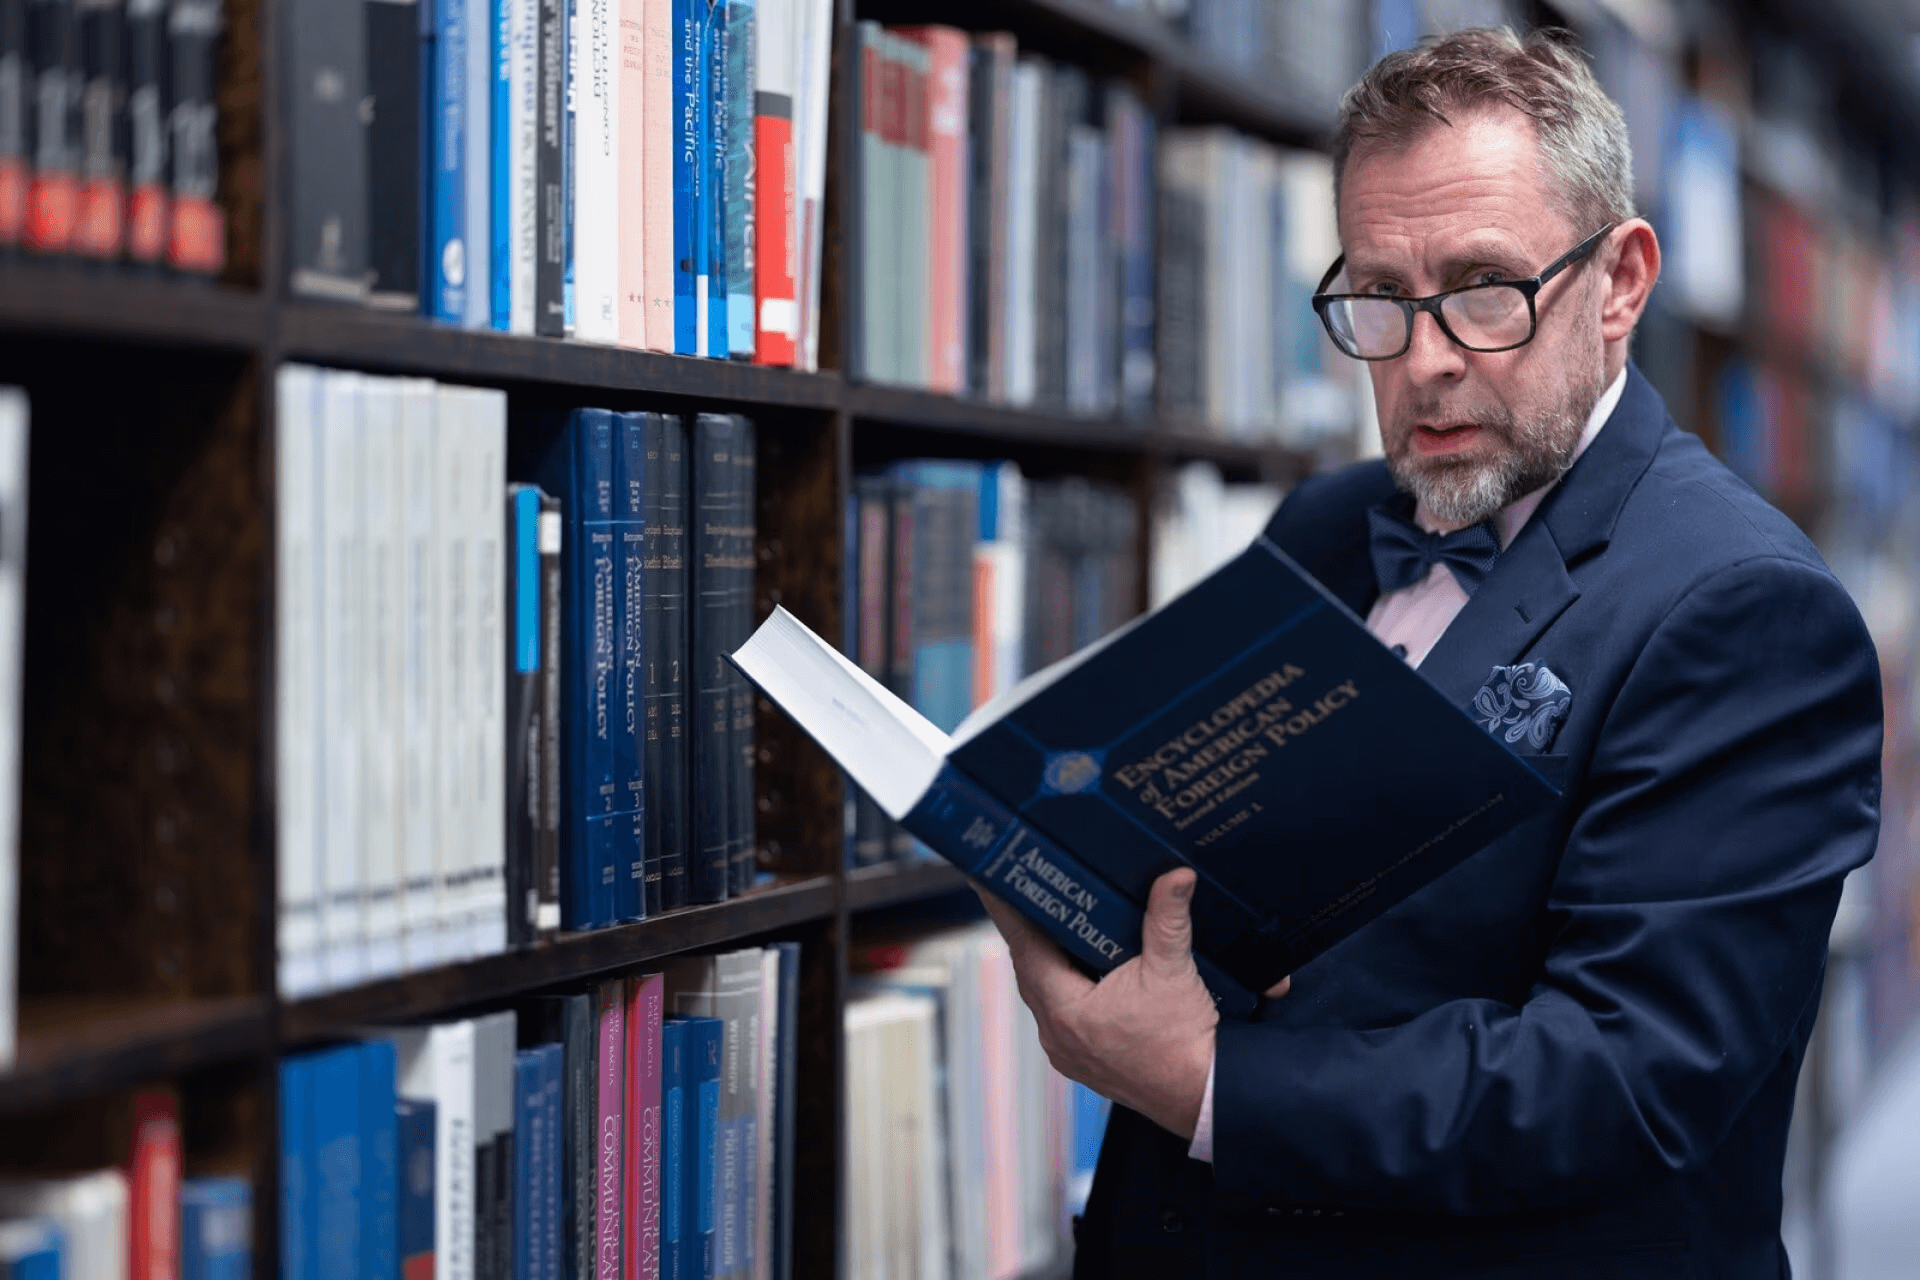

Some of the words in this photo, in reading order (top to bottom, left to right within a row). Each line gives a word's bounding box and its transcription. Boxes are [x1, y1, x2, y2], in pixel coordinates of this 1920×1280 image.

[684, 18, 693, 52] and
[684, 57, 693, 84] the
[684, 92, 696, 163] Pacific
[714, 100, 723, 170] Pacific
[594, 558, 606, 654] FOREIGN
[604, 557, 614, 670] AMERICAN
[625, 556, 634, 651] FOREIGN
[634, 556, 643, 668] AMERICAN
[596, 660, 608, 740] POLICY
[626, 659, 635, 735] POLICY
[1113, 662, 1305, 790] ENCYCLOPEDIA
[1139, 781, 1163, 805] of
[1163, 697, 1293, 791] AMERICAN
[1153, 741, 1270, 821] FOREIGN
[1264, 679, 1360, 748] POLICY
[1003, 863, 1072, 924] FOREIGN
[1067, 911, 1124, 961] POLICY
[1019, 846, 1099, 913] AMERICAN
